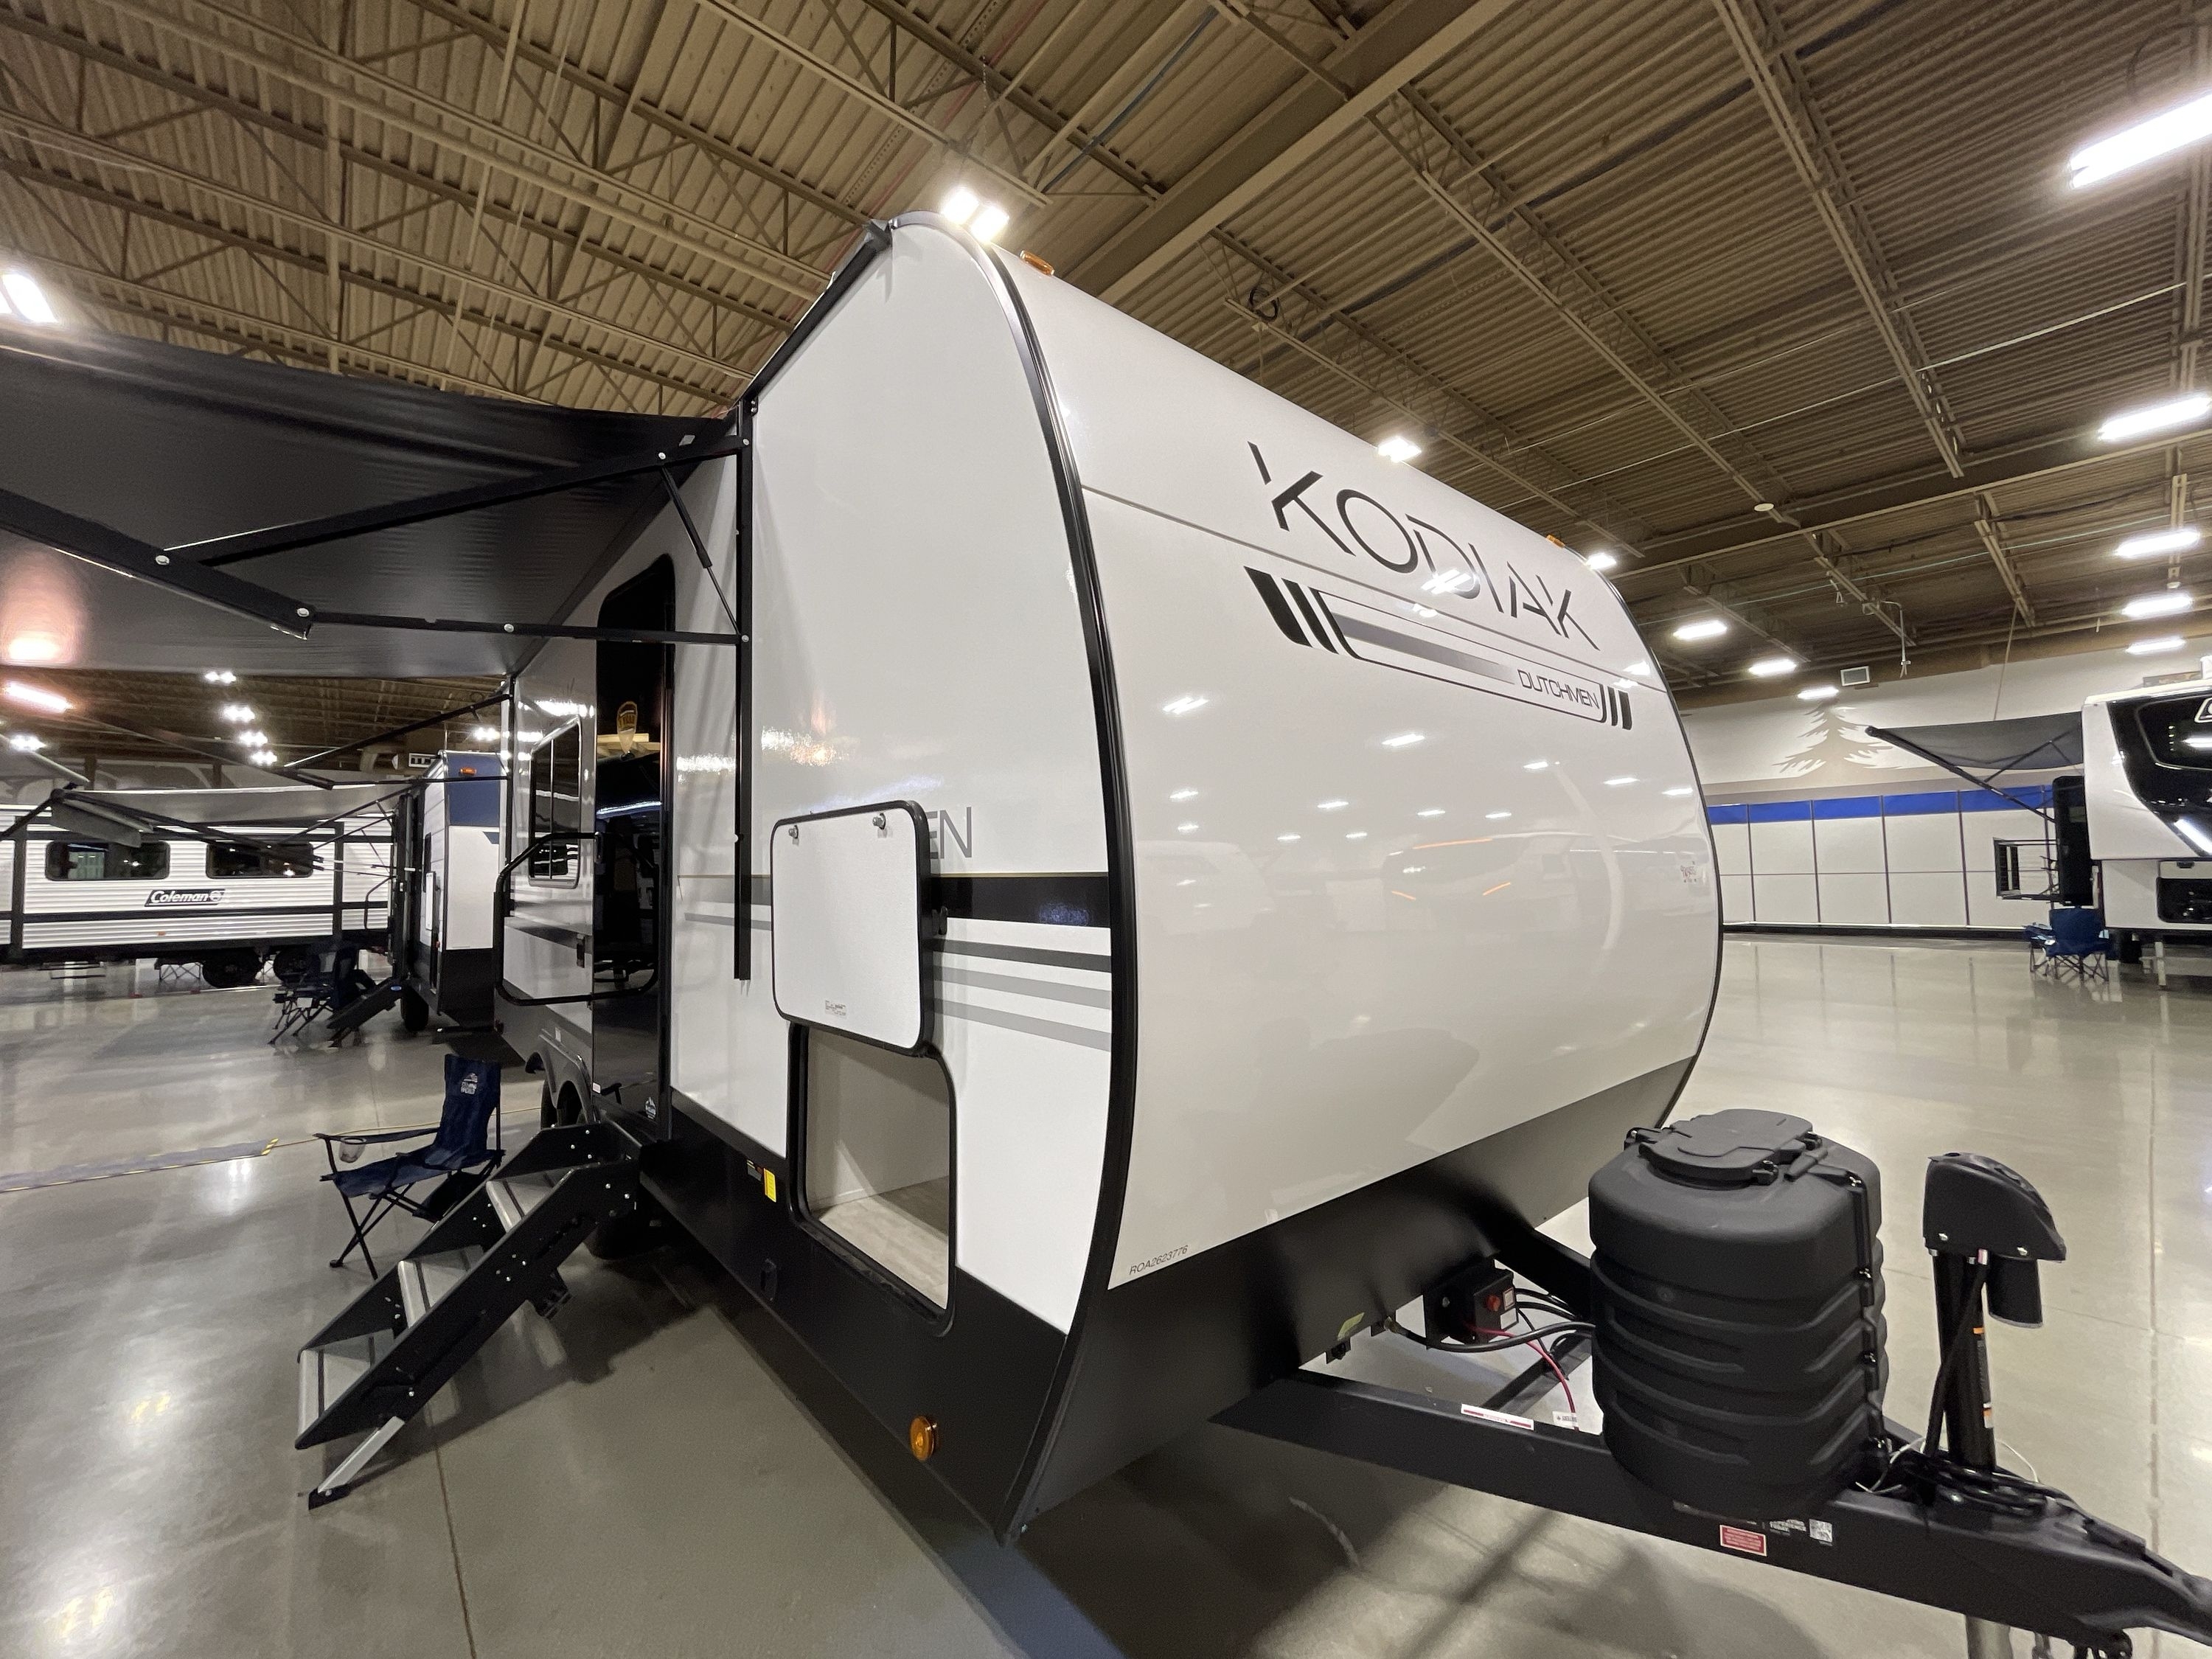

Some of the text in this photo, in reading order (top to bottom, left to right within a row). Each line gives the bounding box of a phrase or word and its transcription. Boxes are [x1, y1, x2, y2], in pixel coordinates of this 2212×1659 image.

[1248, 441, 1600, 650] KODIAK
[1517, 669, 1600, 709] DUTCHMEN
[150, 890, 209, 903] Coleman
